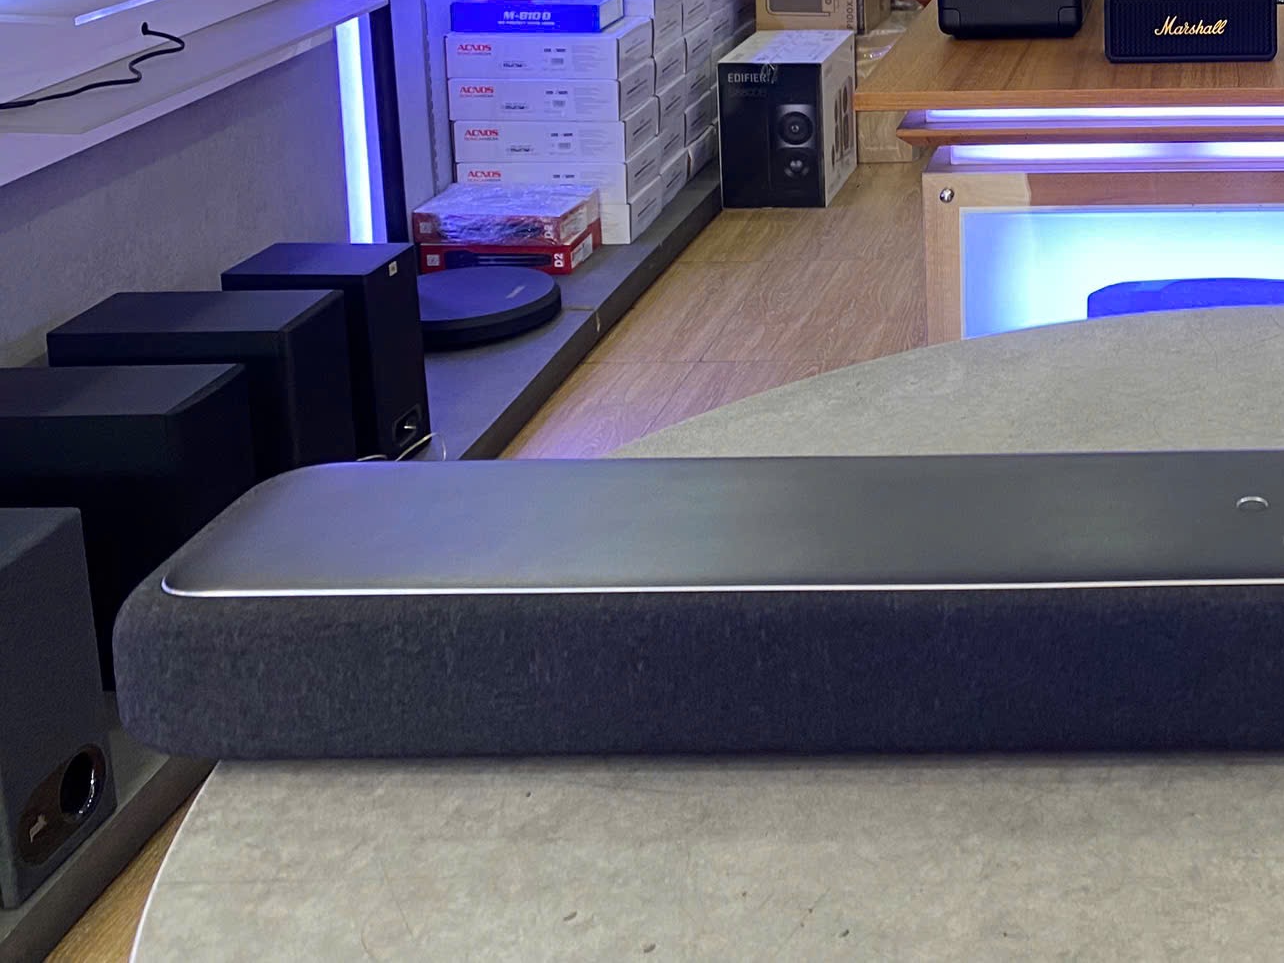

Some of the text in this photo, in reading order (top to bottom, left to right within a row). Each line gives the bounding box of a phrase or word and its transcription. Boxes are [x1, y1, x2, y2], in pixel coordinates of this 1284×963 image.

[1154, 15, 1228, 36] Marshall
[457, 44, 492, 52] ACNOS
[727, 71, 767, 84] EDIFIER
[460, 86, 494, 94] ACNOS
[464, 129, 499, 137] ACNOS
[467, 170, 501, 179] ACNOS
[554, 252, 565, 269] D2
